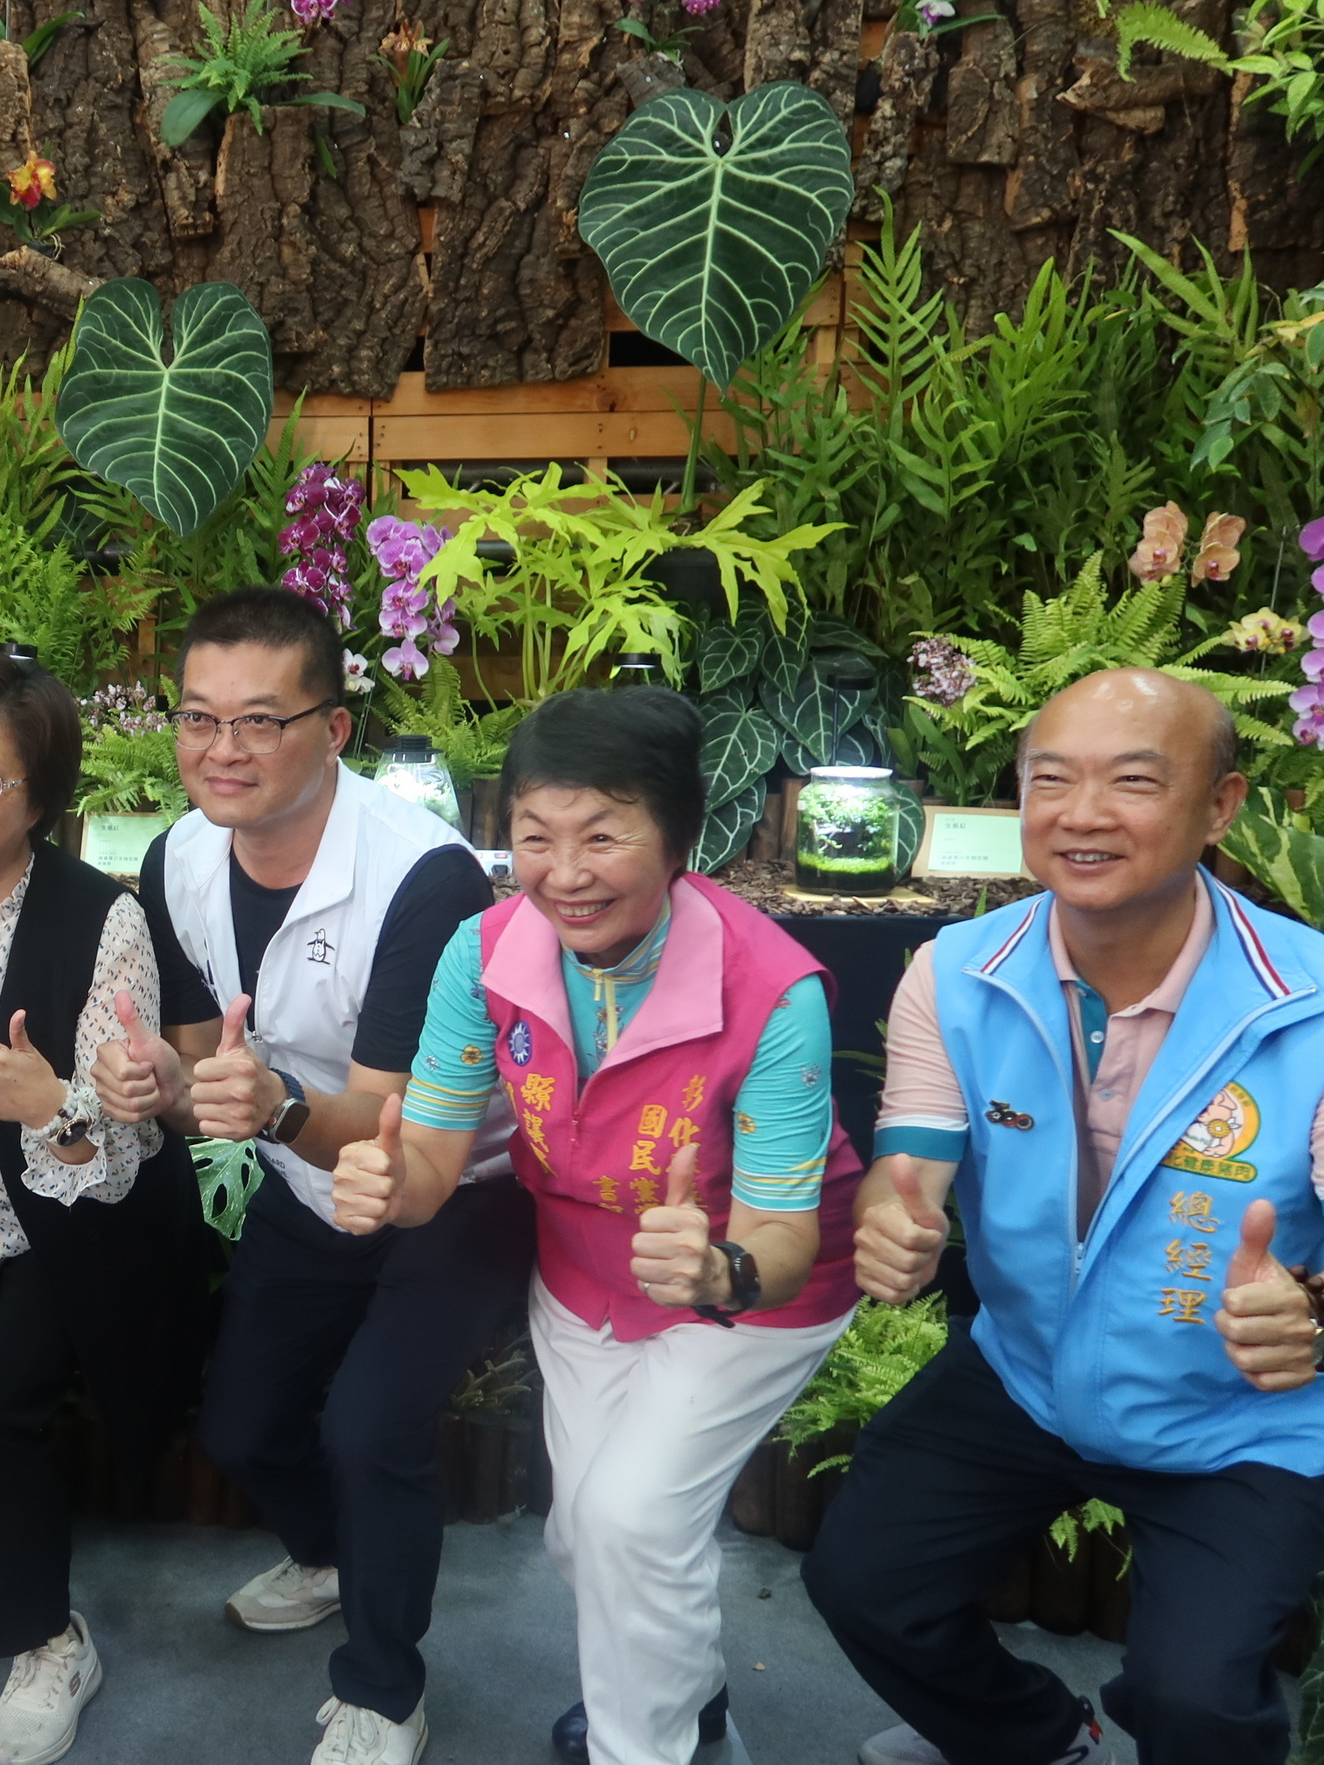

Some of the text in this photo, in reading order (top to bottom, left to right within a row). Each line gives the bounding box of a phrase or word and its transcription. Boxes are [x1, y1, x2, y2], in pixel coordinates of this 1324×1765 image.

[520, 1073, 558, 1178] 縣議
[628, 1104, 668, 1214] 國民黨
[1158, 1191, 1219, 1324] 總經理
